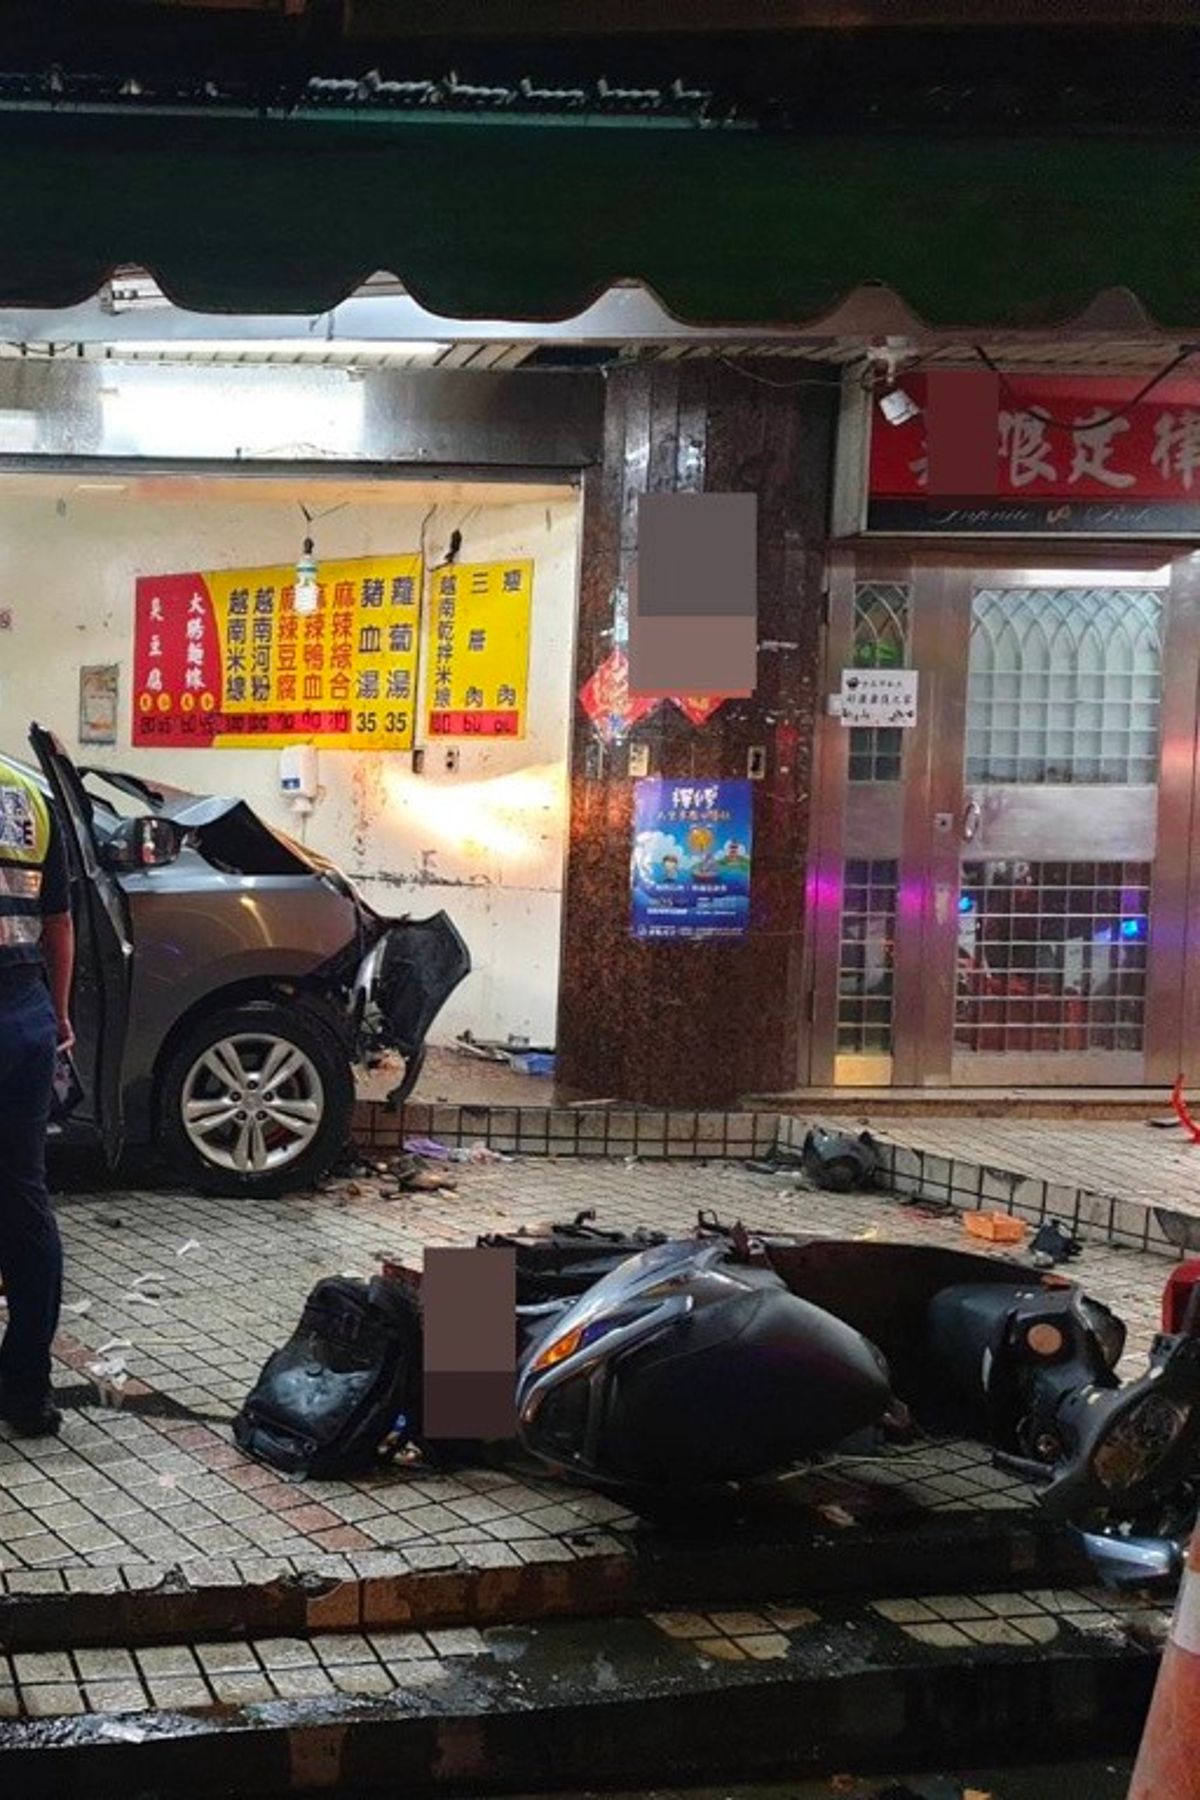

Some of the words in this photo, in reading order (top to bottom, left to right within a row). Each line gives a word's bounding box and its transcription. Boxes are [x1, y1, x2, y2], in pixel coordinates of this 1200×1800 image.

[910, 405, 1200, 491] 限定律
[226, 586, 250, 702] 越南米線
[250, 585, 275, 702] 越南河粉
[355, 577, 386, 700] 豬血湯
[356, 711, 378, 733] 35
[385, 711, 407, 733] 35
